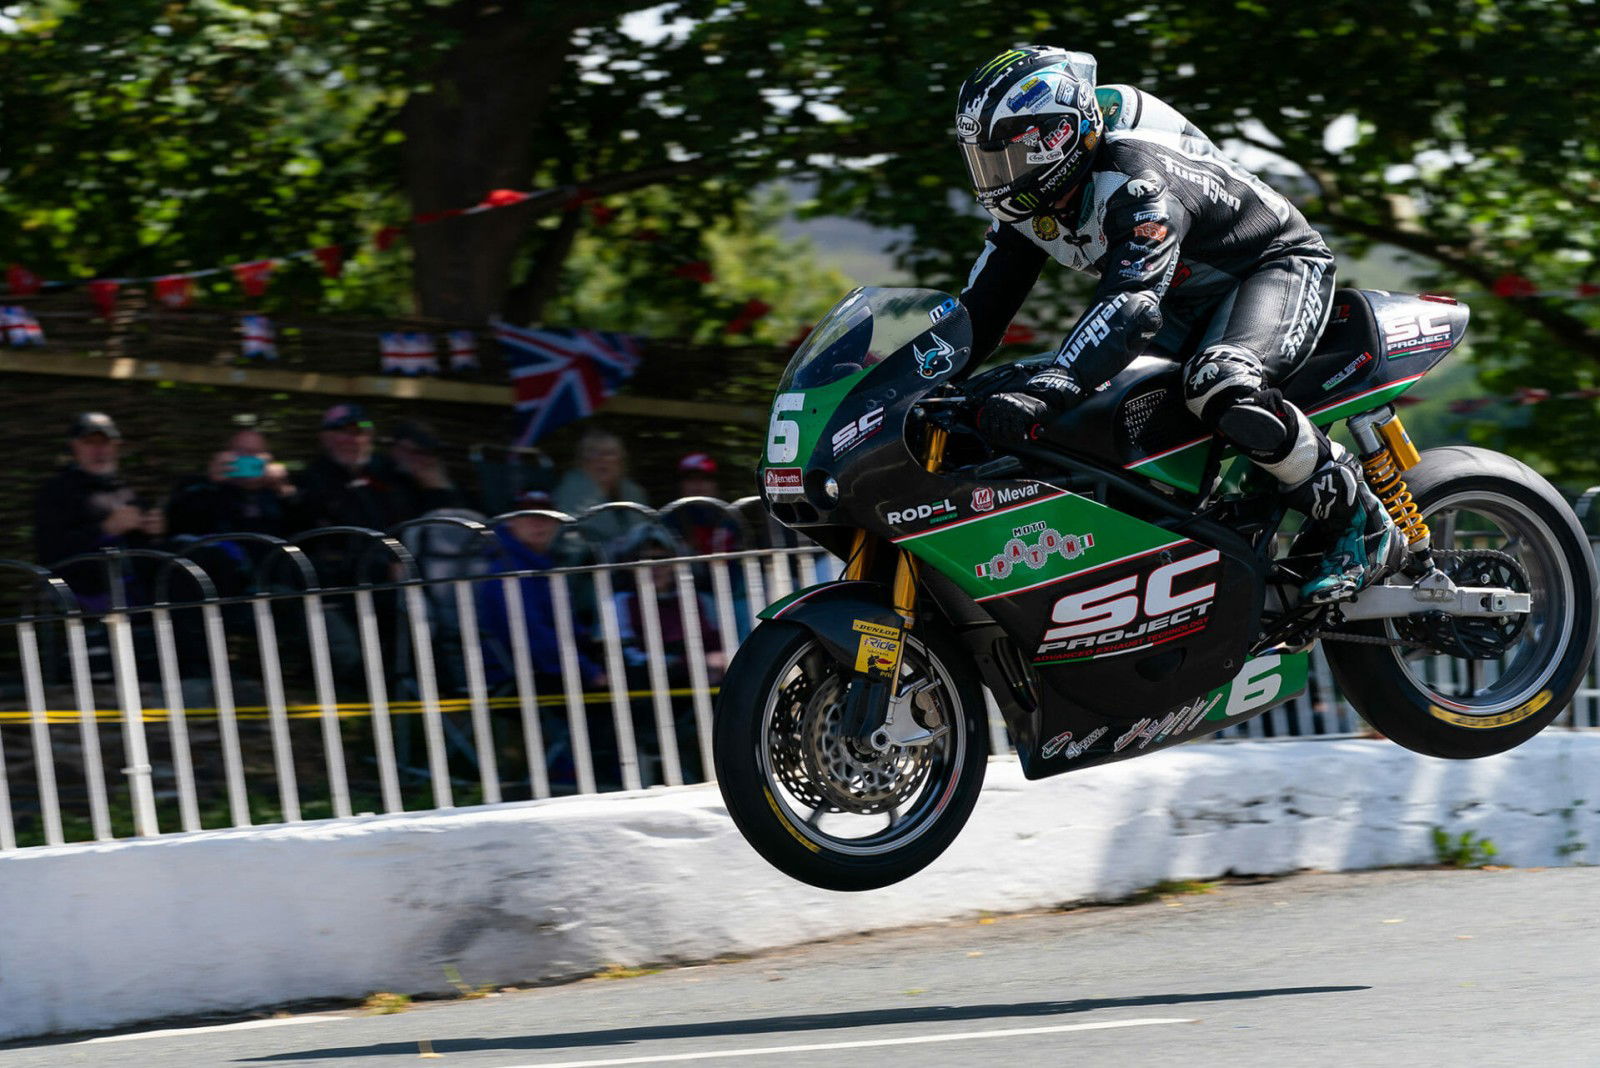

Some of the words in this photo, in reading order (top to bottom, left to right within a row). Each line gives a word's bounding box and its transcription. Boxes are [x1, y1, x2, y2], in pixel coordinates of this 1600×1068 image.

[1040, 149, 1082, 193] MONSTER
[1157, 153, 1241, 212] furygan
[1054, 293, 1129, 368] furygan
[1383, 312, 1452, 344] SC
[1387, 333, 1451, 350] PROJECT
[767, 393, 805, 464] 6
[832, 406, 884, 452] SC
[887, 498, 957, 525] RODEL
[997, 483, 1040, 504] Mevar
[1013, 521, 1046, 537] MOTO
[997, 535, 1075, 572] PATON
[1043, 549, 1220, 642] SC
[859, 625, 898, 636] DUNLOP
[1033, 649, 1093, 662] ADVANCED
[1093, 638, 1144, 655] EXHAUST
[1147, 616, 1209, 642] TECHNOLOGY
[1037, 601, 1213, 654] PROJECT
[1225, 653, 1282, 716] 6
